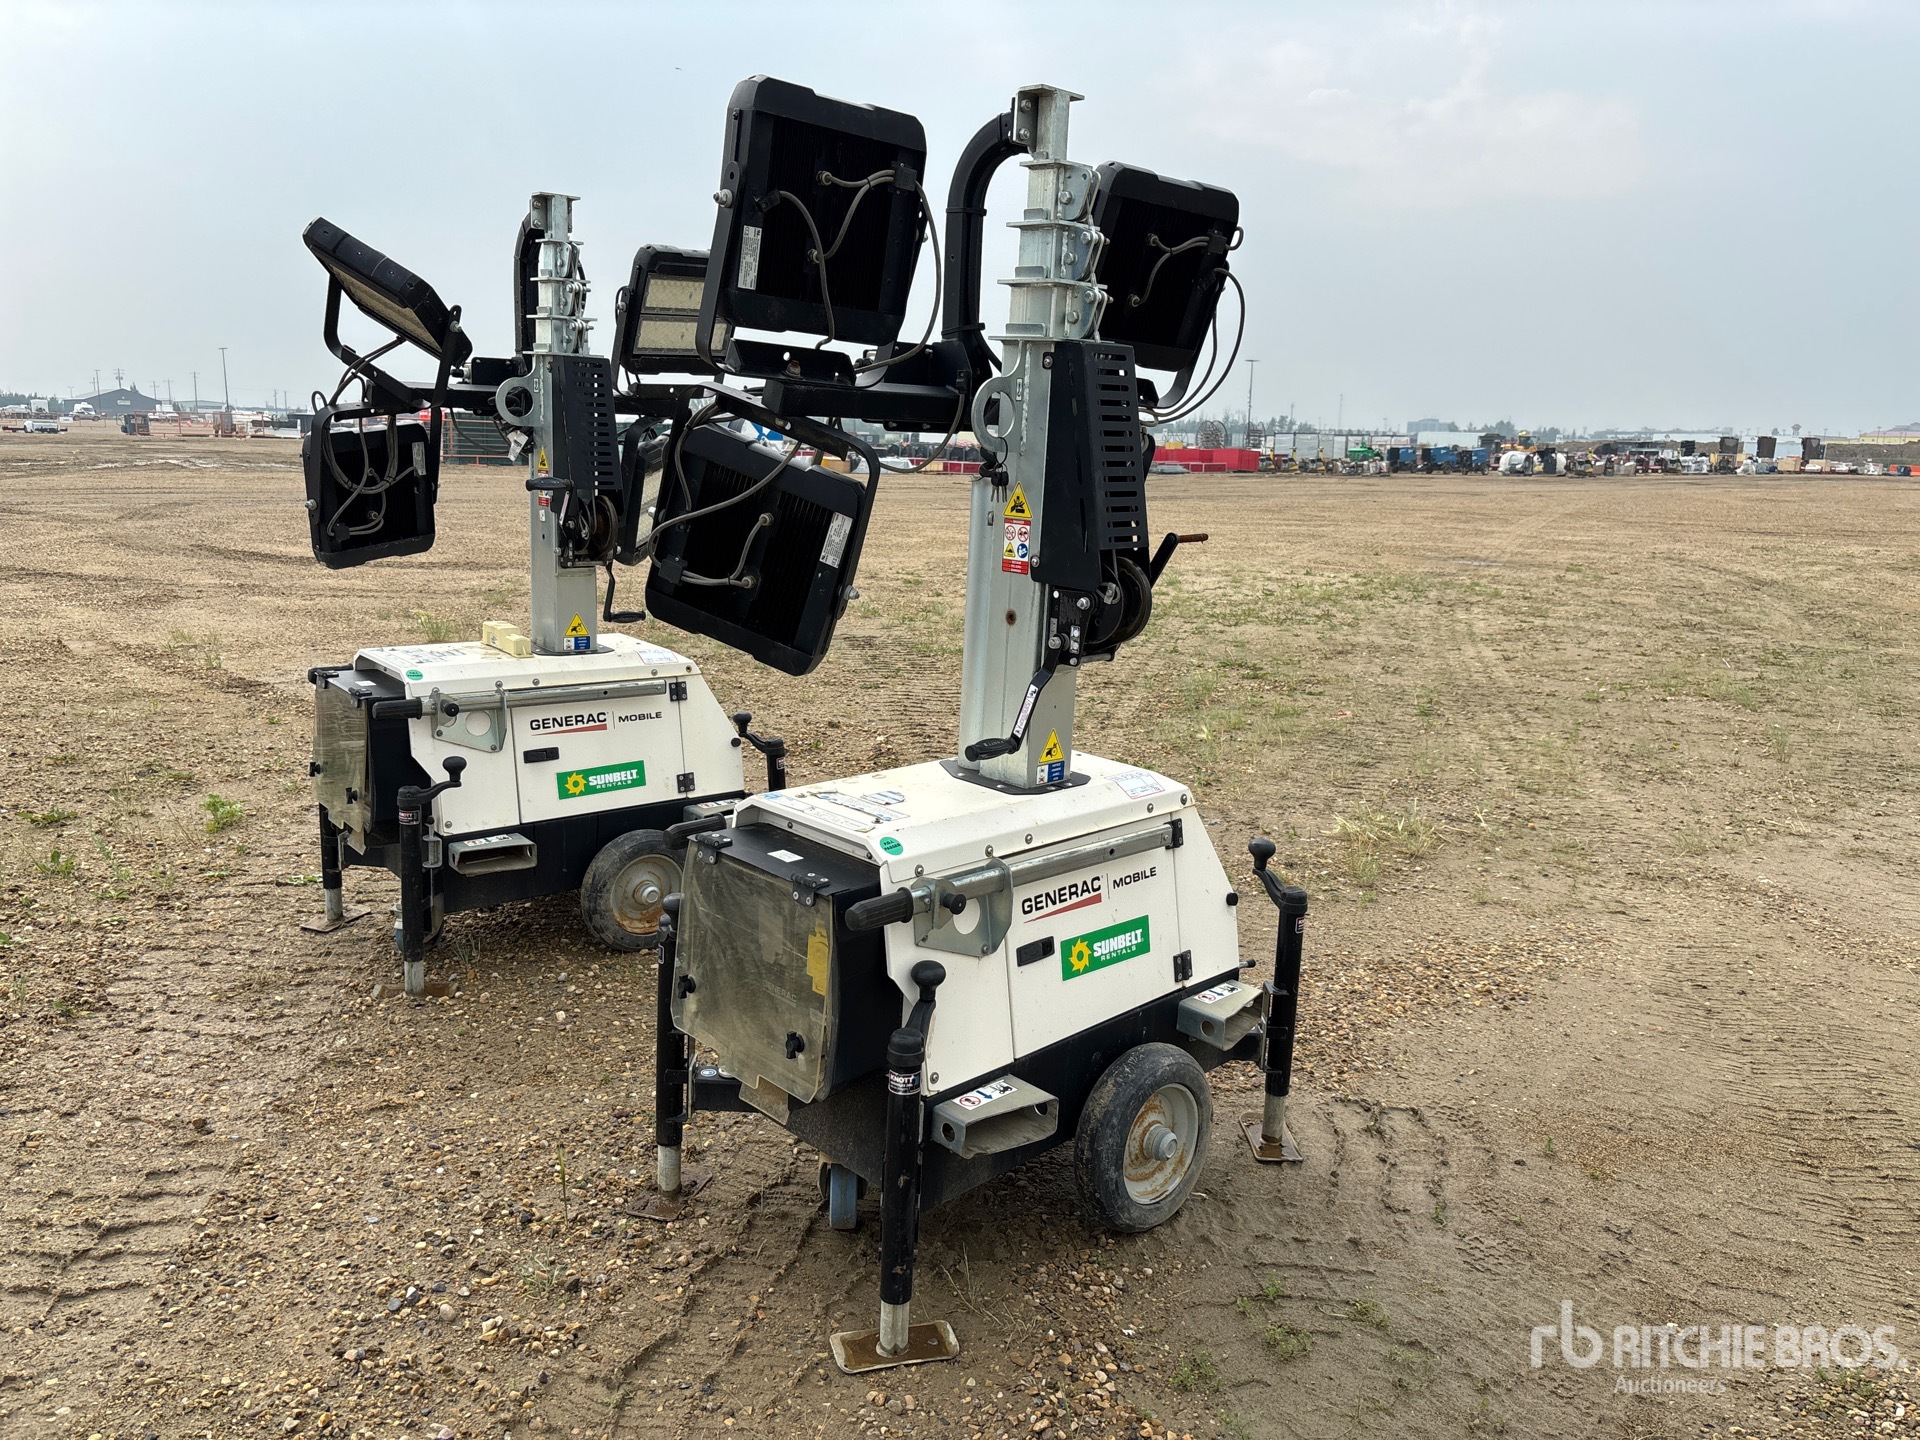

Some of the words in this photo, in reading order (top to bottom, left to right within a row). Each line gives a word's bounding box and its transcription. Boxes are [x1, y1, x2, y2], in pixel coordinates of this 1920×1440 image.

[529, 712, 607, 731] GENERAC
[618, 711, 662, 723] MOBILE
[588, 769, 638, 786] SUNBELT
[596, 780, 632, 789] RENTALS
[1021, 876, 1101, 915] GENERAC
[1112, 866, 1157, 889] MOBILE
[1093, 929, 1142, 957] SUNBELT
[1100, 945, 1136, 961] RENTALS
[890, 1074, 915, 1084] KNOTT
